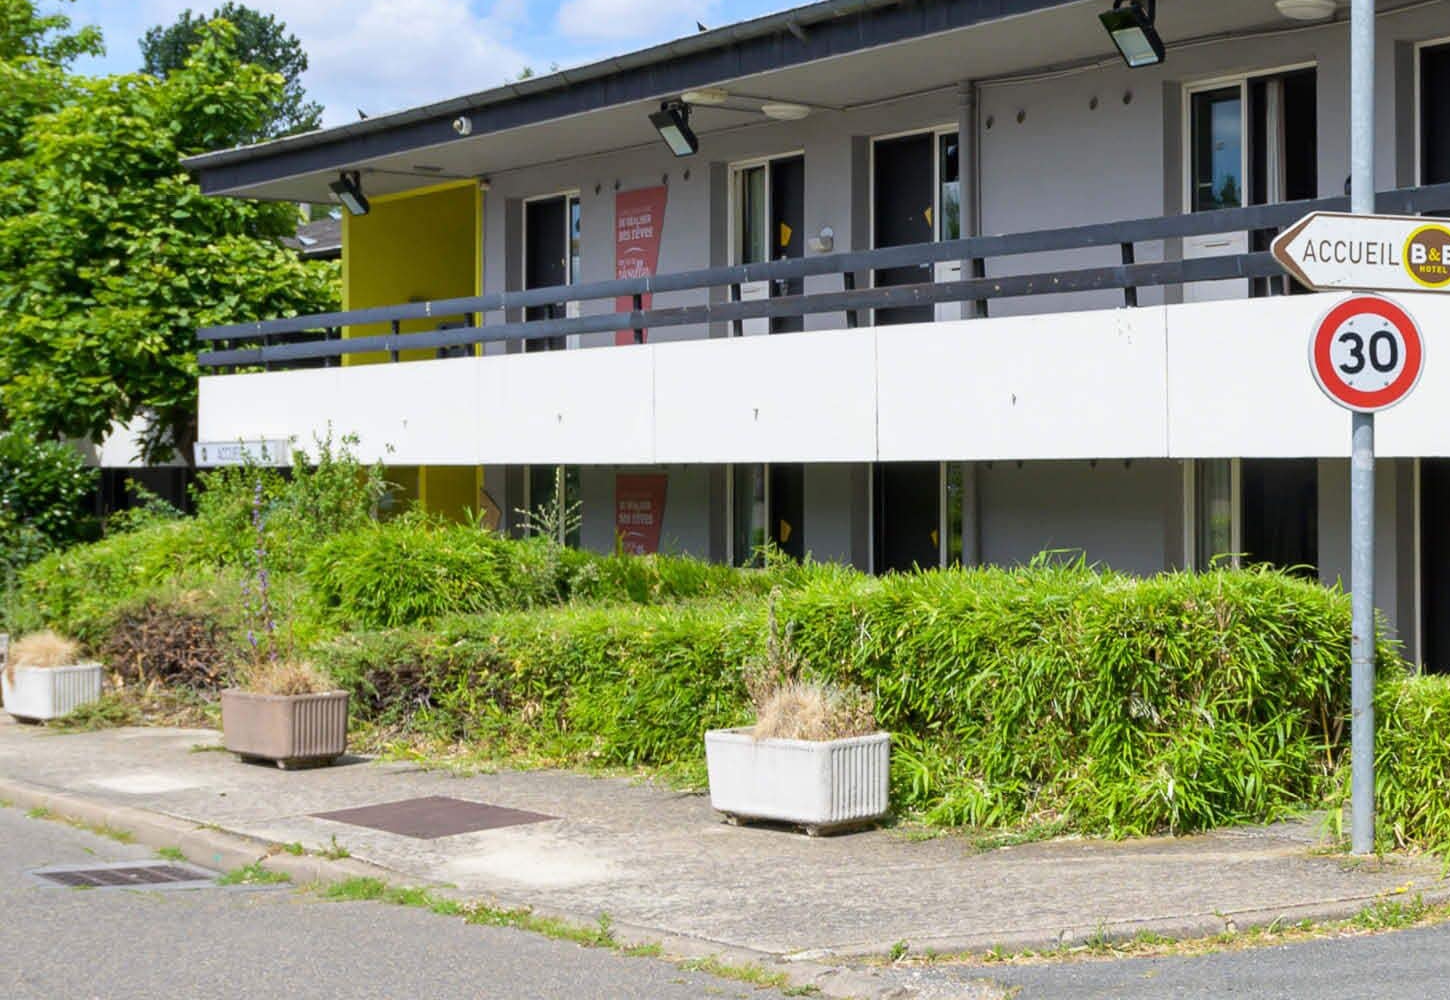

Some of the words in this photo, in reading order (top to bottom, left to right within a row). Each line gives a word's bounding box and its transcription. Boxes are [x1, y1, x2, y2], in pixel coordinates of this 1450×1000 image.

[1302, 239, 1400, 267] ACCUEIL
[1419, 265, 1448, 274] HOTEL
[1338, 330, 1399, 375] 30
